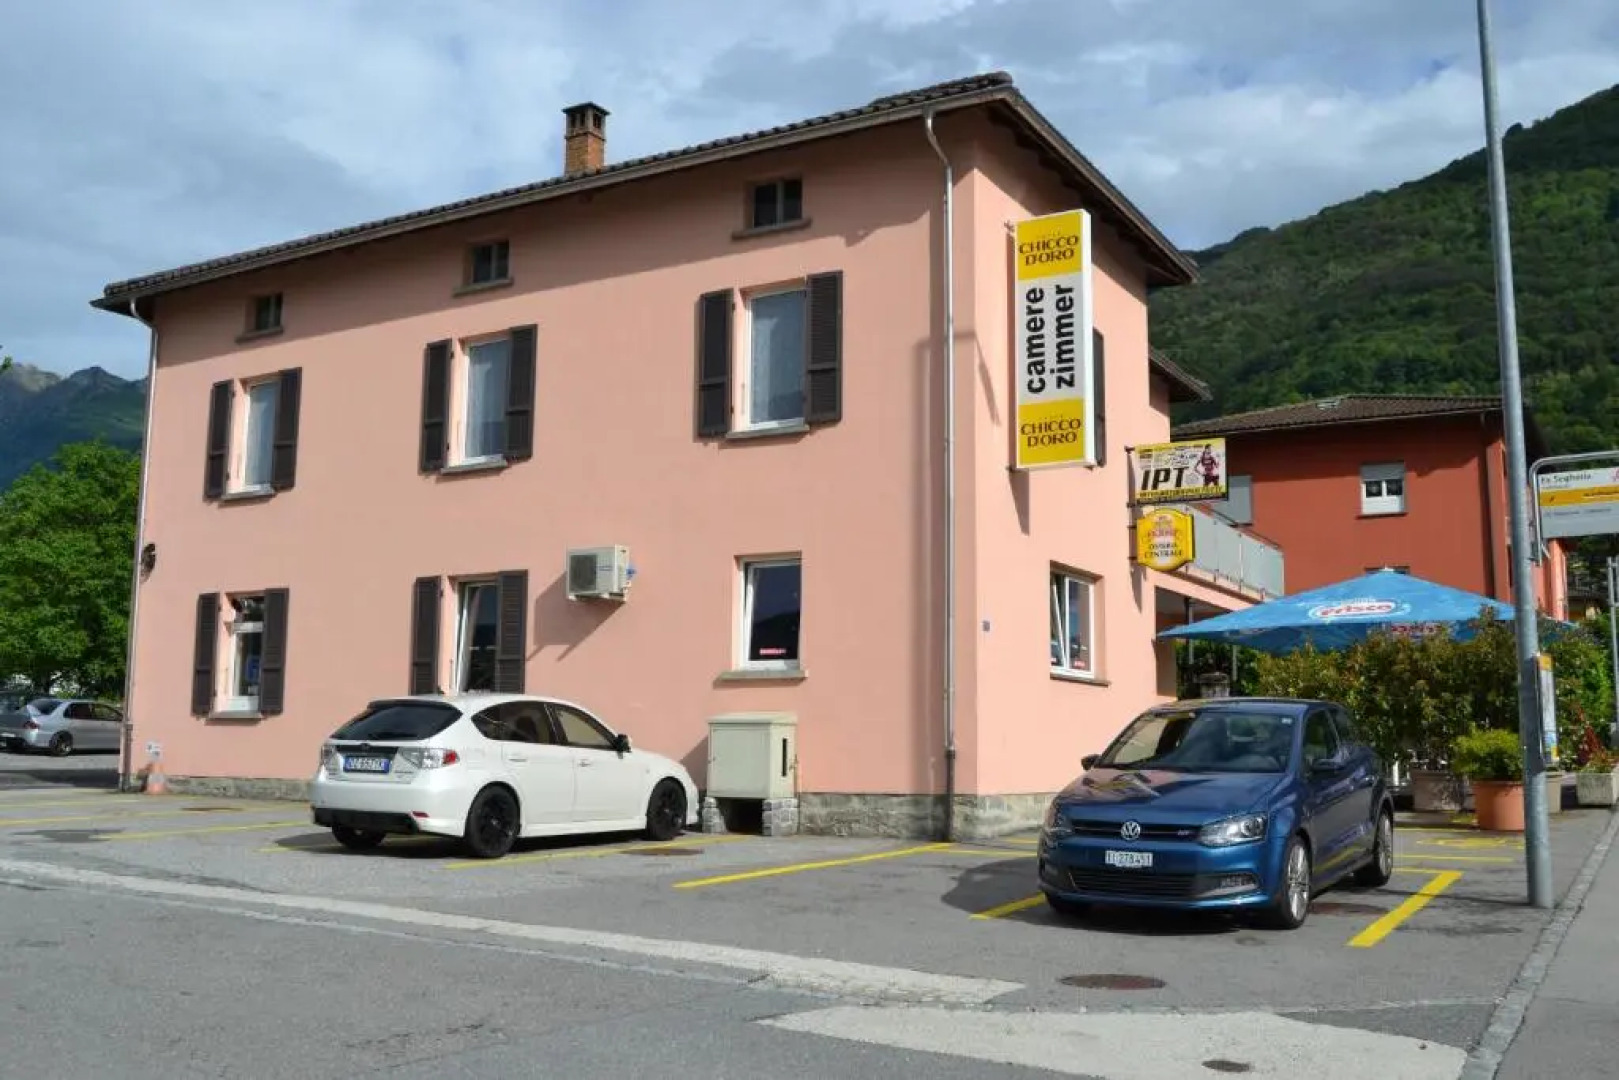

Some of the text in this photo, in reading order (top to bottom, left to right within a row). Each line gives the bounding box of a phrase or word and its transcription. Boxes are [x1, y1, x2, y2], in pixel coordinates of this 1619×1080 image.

[1019, 235, 1079, 254] CHICCO
[1025, 286, 1046, 395] camere
[1049, 284, 1075, 390] zimmer
[1020, 418, 1081, 436] CHICCO
